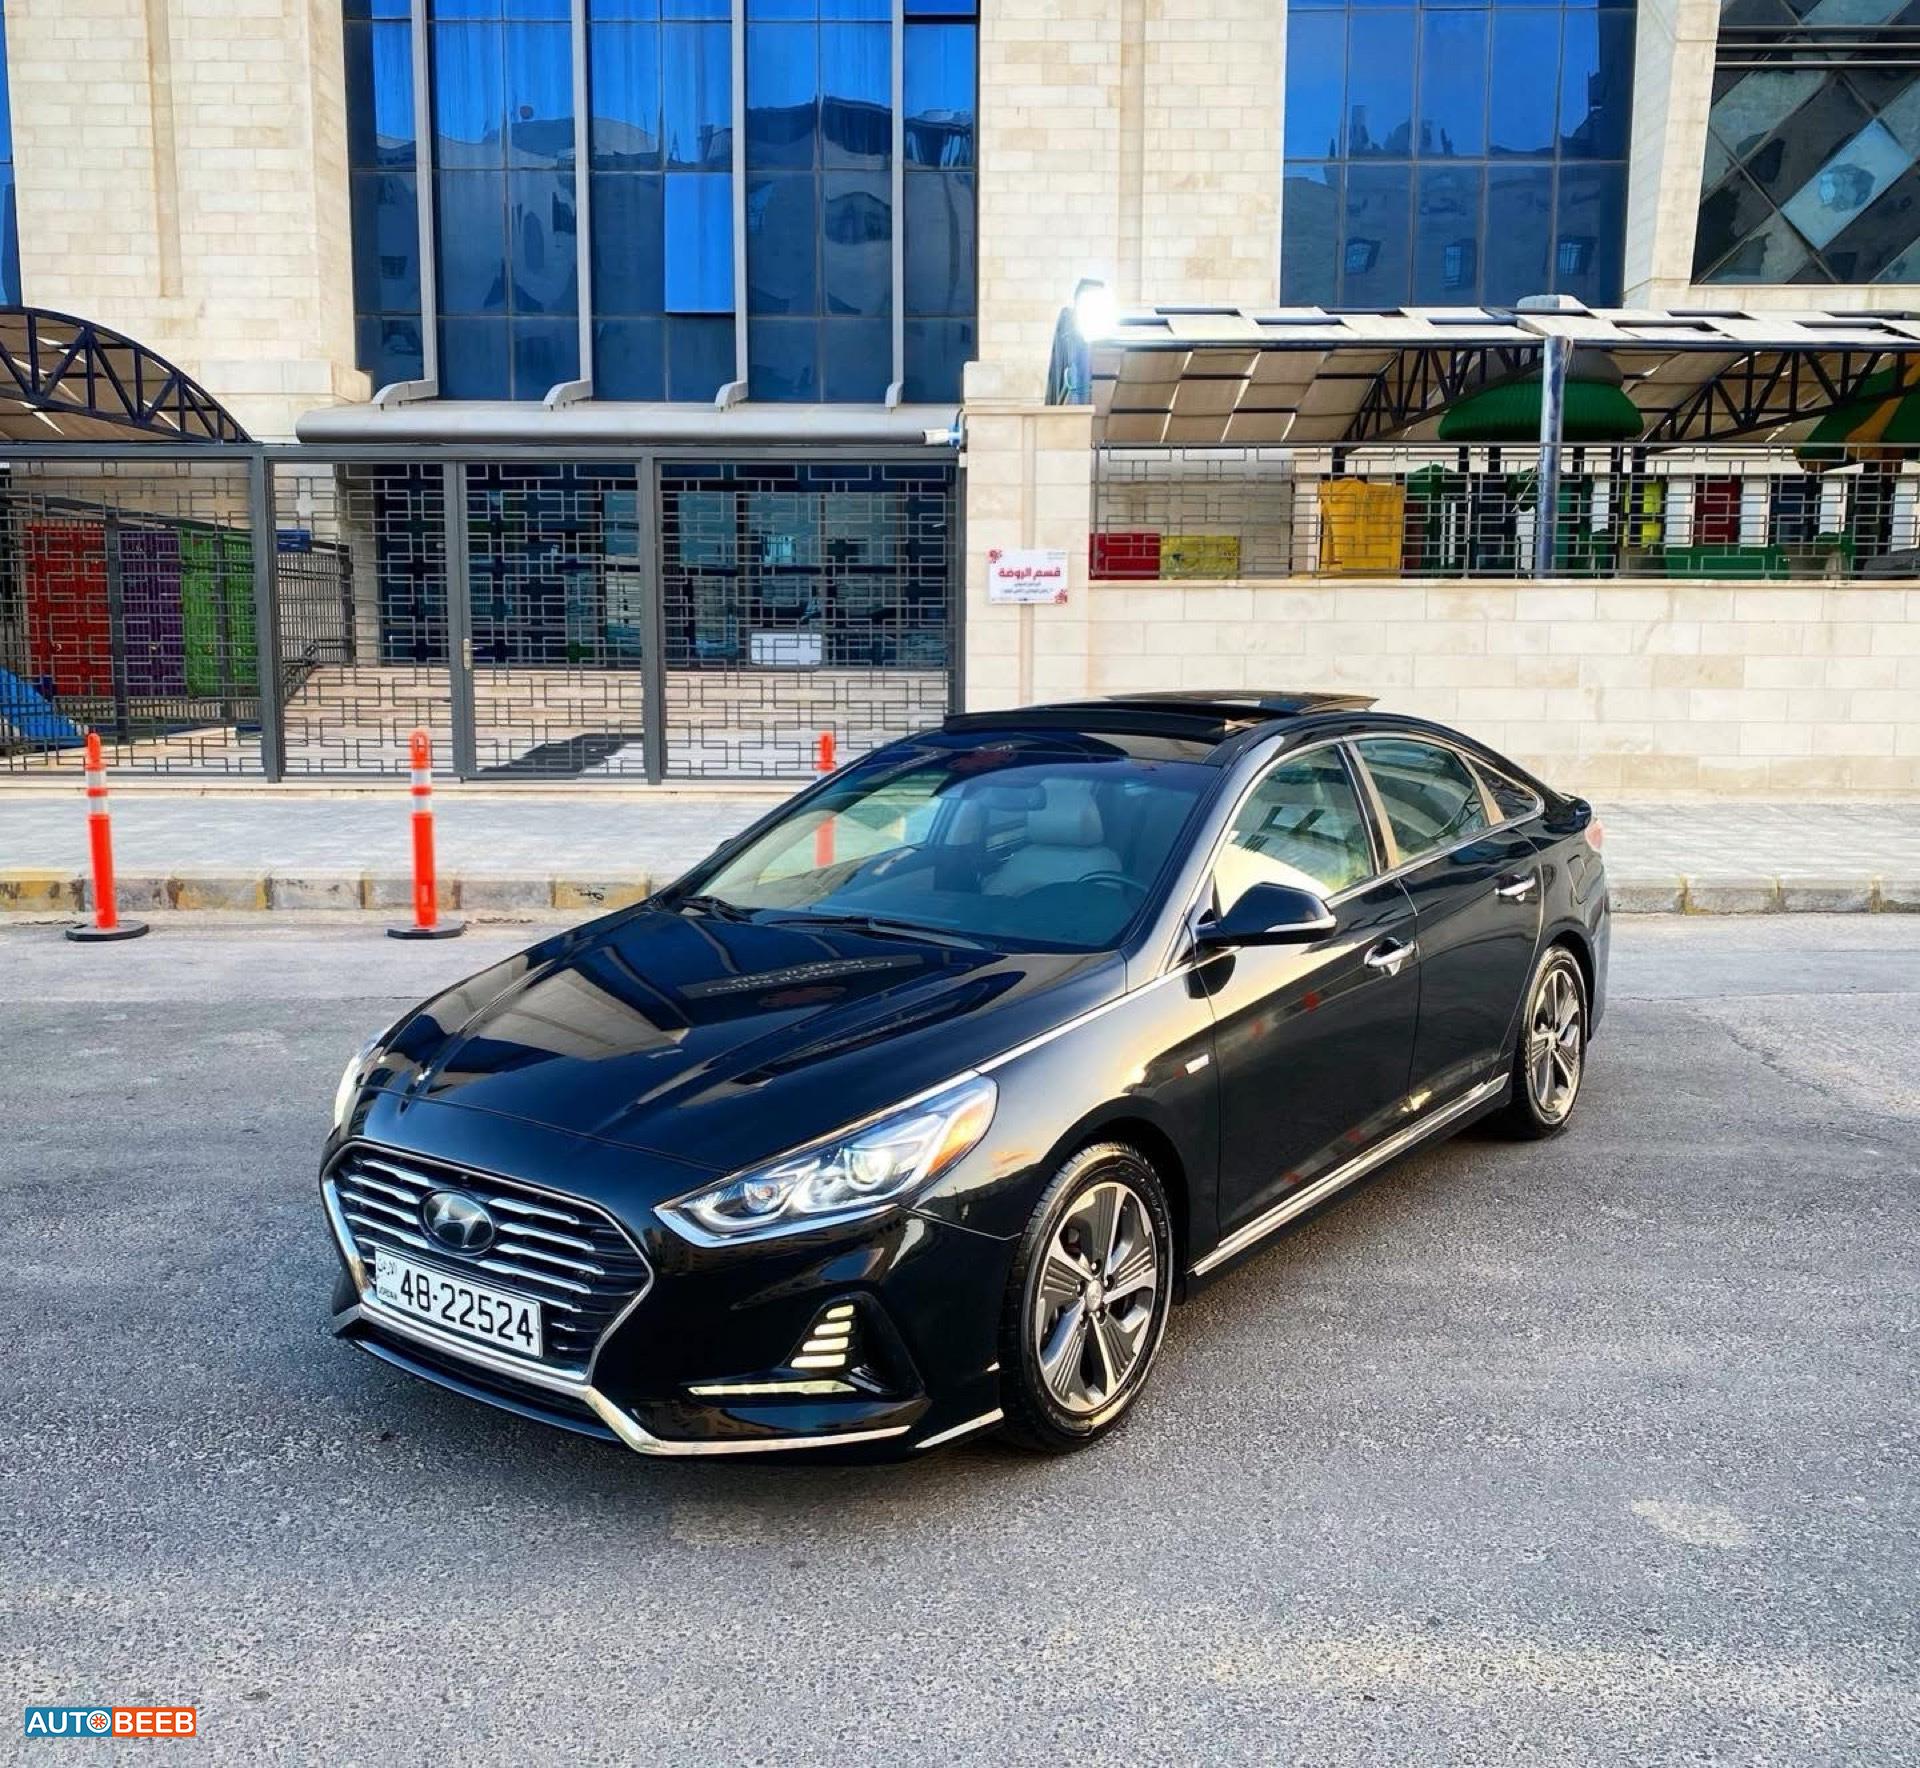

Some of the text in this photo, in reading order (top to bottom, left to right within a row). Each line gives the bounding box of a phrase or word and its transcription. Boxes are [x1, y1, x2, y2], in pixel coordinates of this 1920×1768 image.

[999, 566, 1061, 580] قسم الروضة
[400, 1268, 533, 1347] 48-22524
